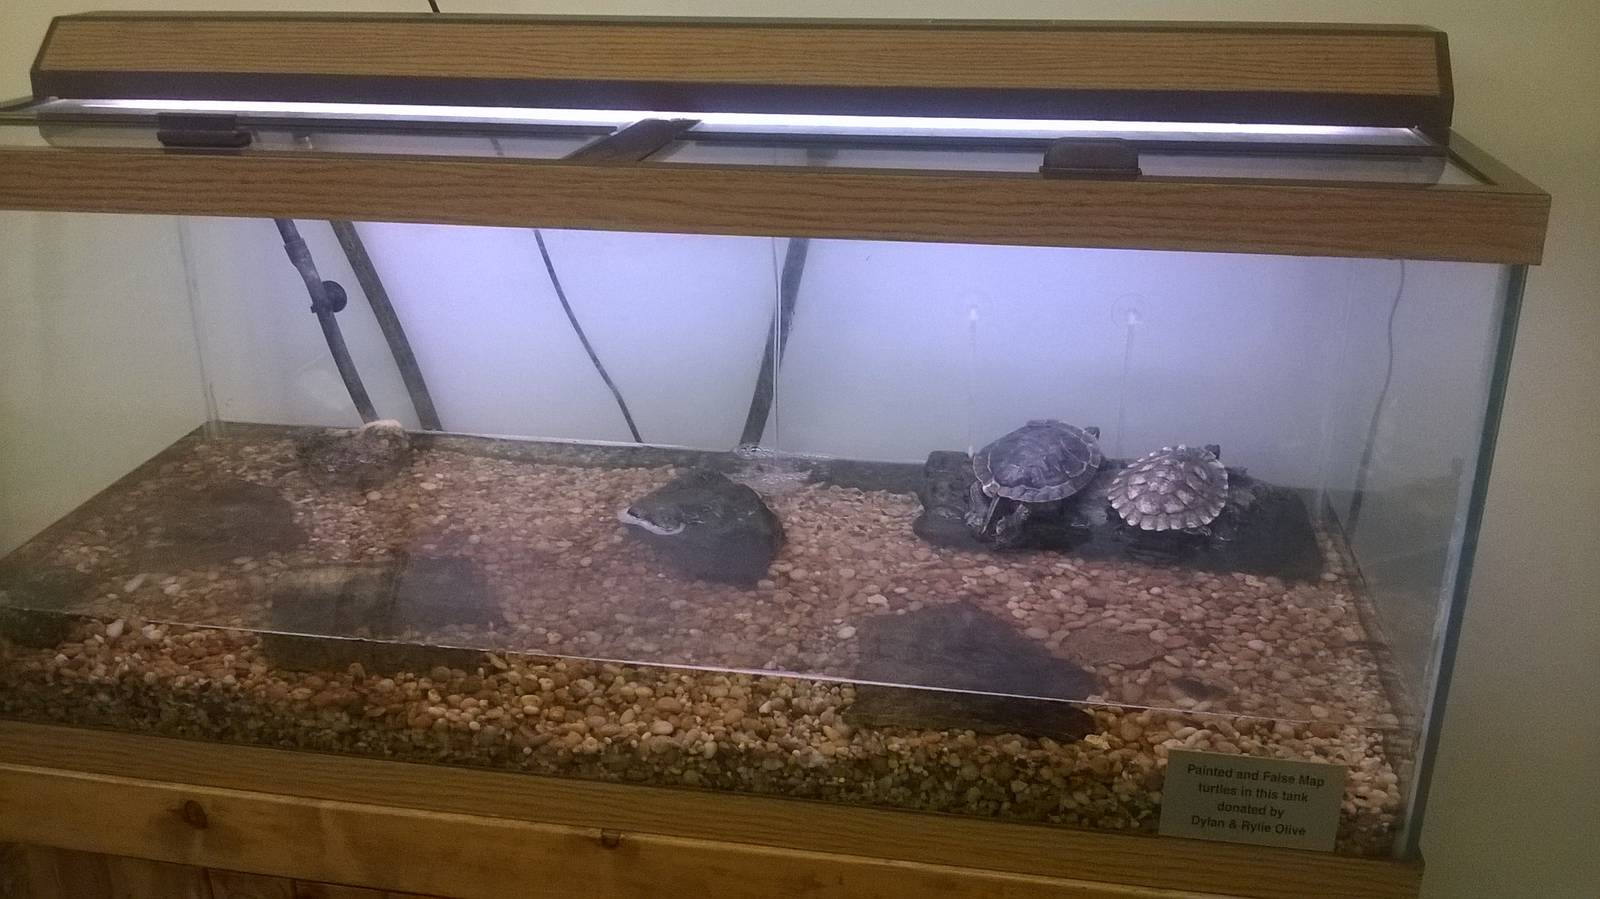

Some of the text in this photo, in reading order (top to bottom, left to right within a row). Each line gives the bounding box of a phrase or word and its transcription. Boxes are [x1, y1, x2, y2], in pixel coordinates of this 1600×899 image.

[1187, 764, 1325, 788] Painted and False Map
[1199, 783, 1309, 803] turtles in this tank
[1217, 801, 1285, 819] donated by
[1191, 815, 1307, 836] Dylan & Rylie Olive
